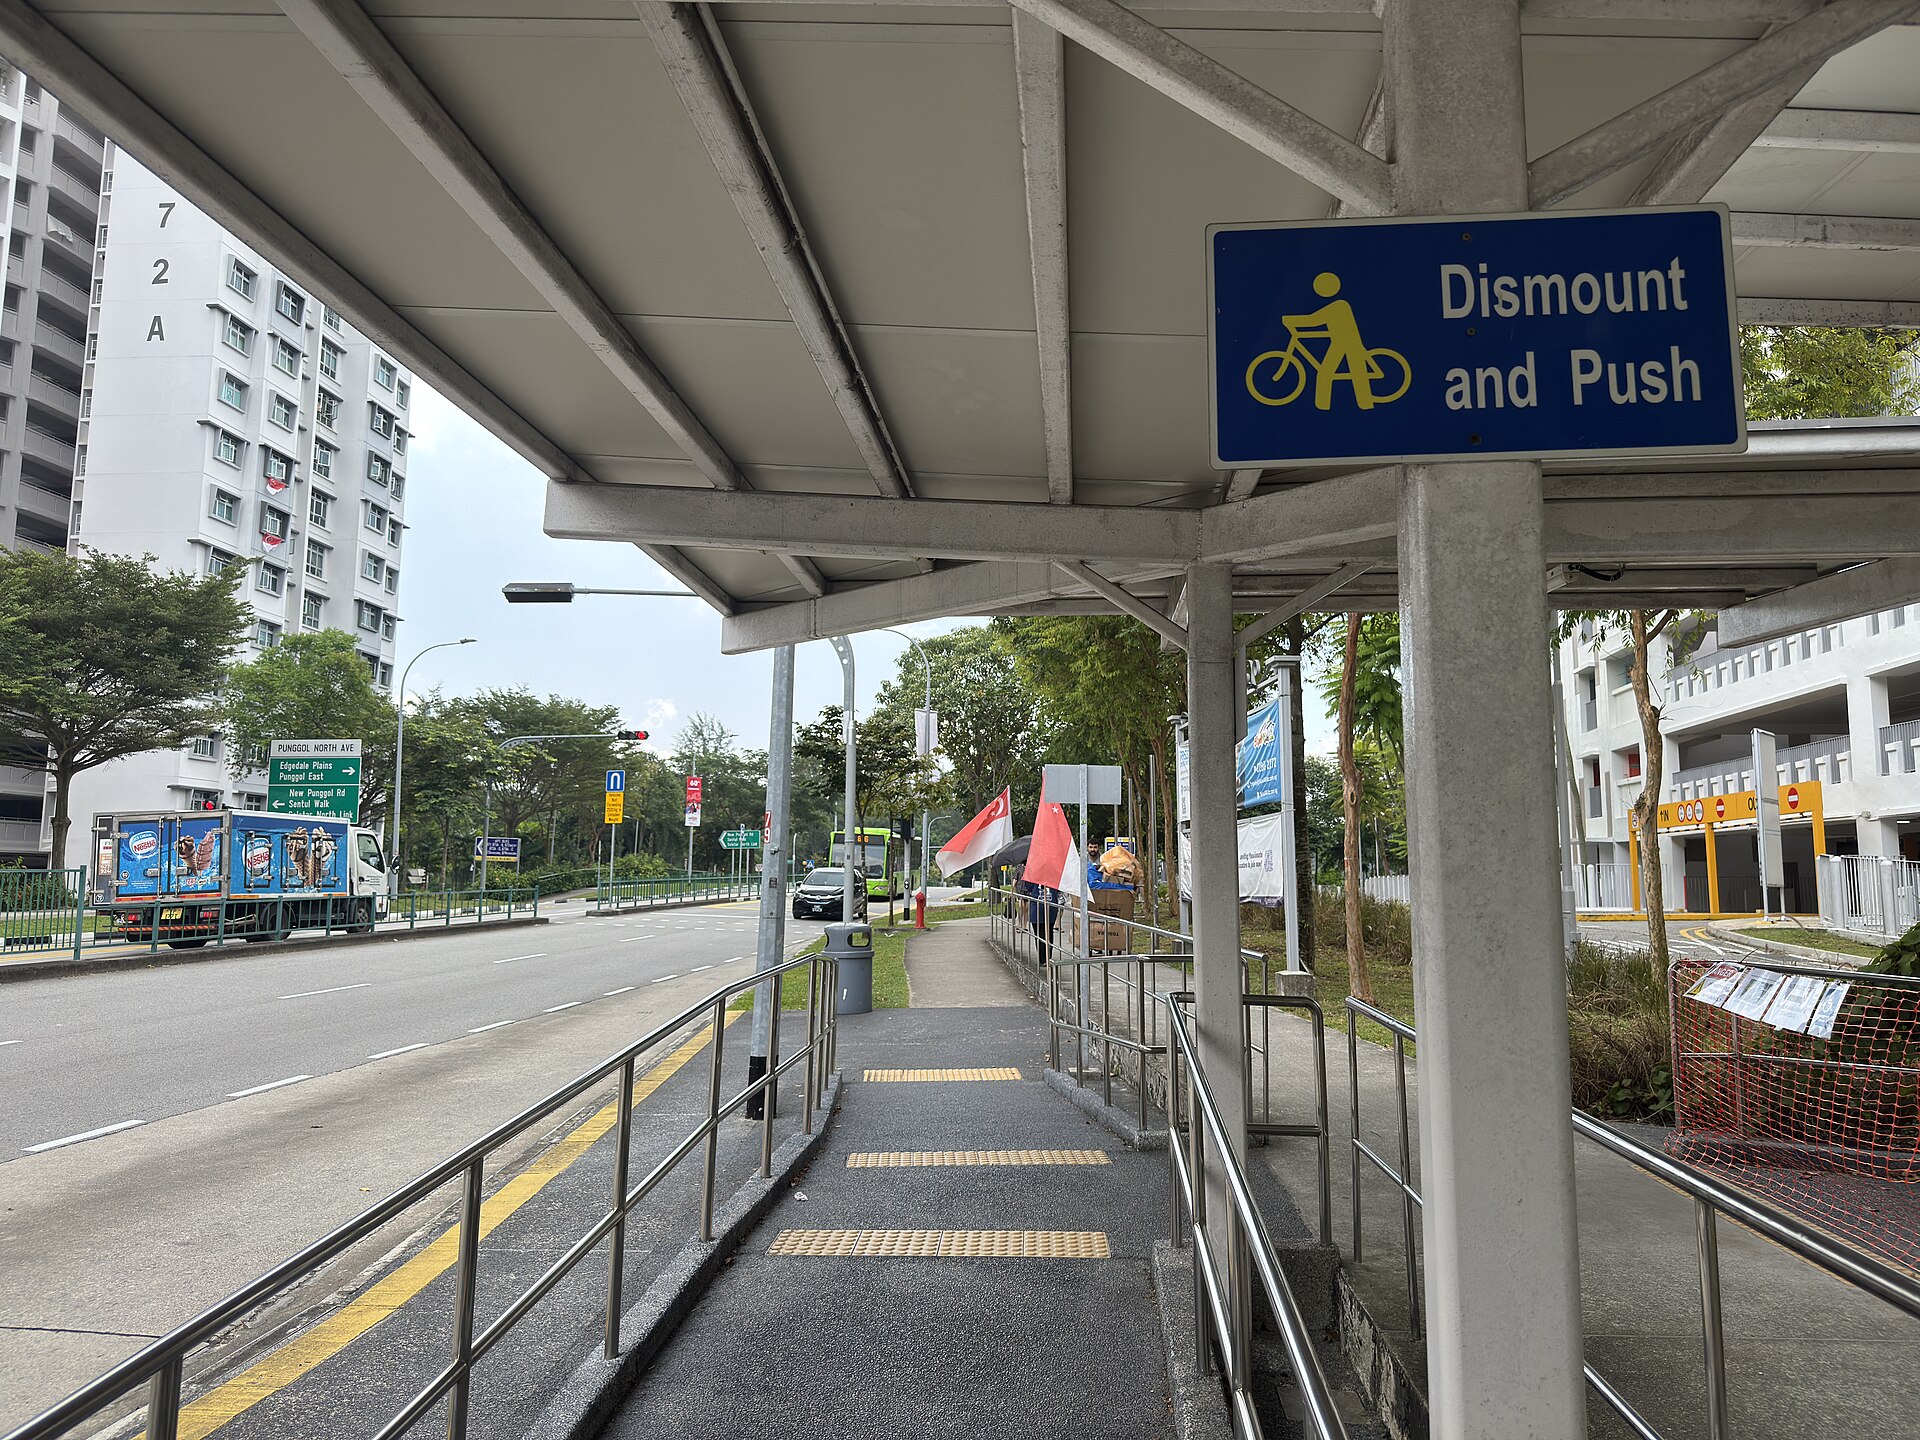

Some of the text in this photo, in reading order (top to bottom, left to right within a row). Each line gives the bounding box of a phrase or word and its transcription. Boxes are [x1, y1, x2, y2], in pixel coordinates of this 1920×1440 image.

[1440, 256, 1688, 320] Dismount
[1445, 346, 1702, 410] and Push
[278, 743, 354, 752] PUNGGOL NORTH AVE
[280, 761, 333, 771] Edgedale Plains
[279, 772, 324, 782] Punggol East
[289, 788, 346, 799] New Punggol Rd
[288, 799, 330, 808] Sentul Walk
[339, 810, 353, 818] Link
[1663, 809, 1669, 822] IN
[764, 811, 771, 844] 79
